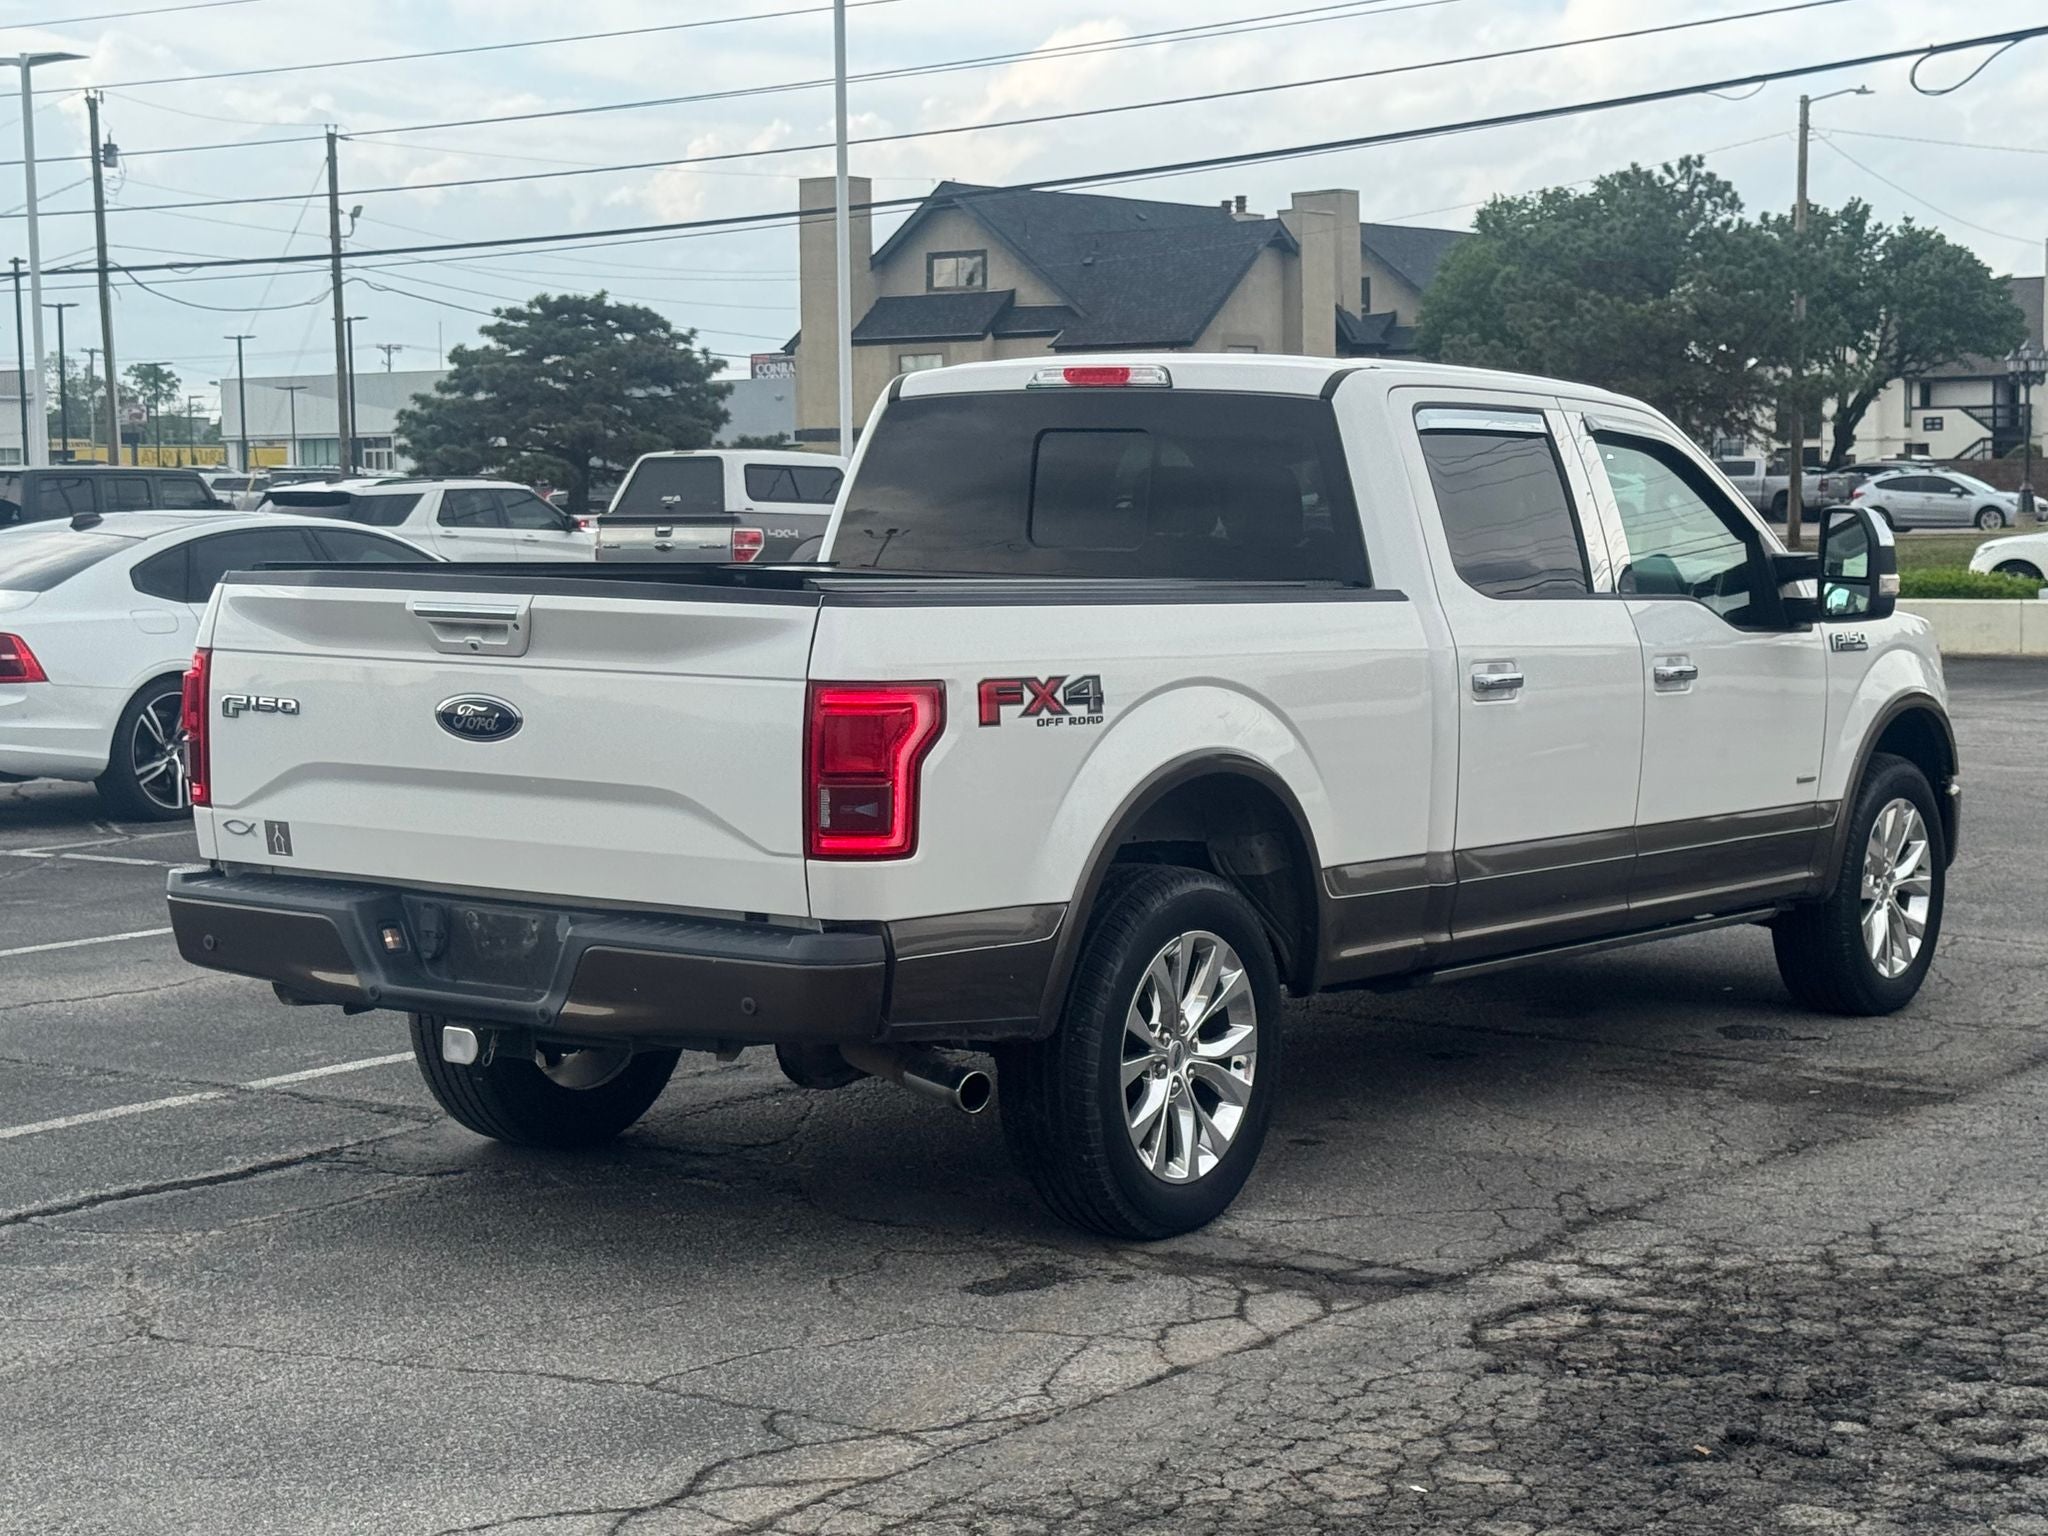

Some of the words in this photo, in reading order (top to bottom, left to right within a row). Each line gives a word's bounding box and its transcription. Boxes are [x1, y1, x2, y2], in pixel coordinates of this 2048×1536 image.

[221, 693, 300, 718] F150
[978, 675, 1104, 728] FX4
[453, 703, 500, 731] Ford
[1036, 717, 1064, 728] OFF
[1068, 715, 1104, 726] ROAD
